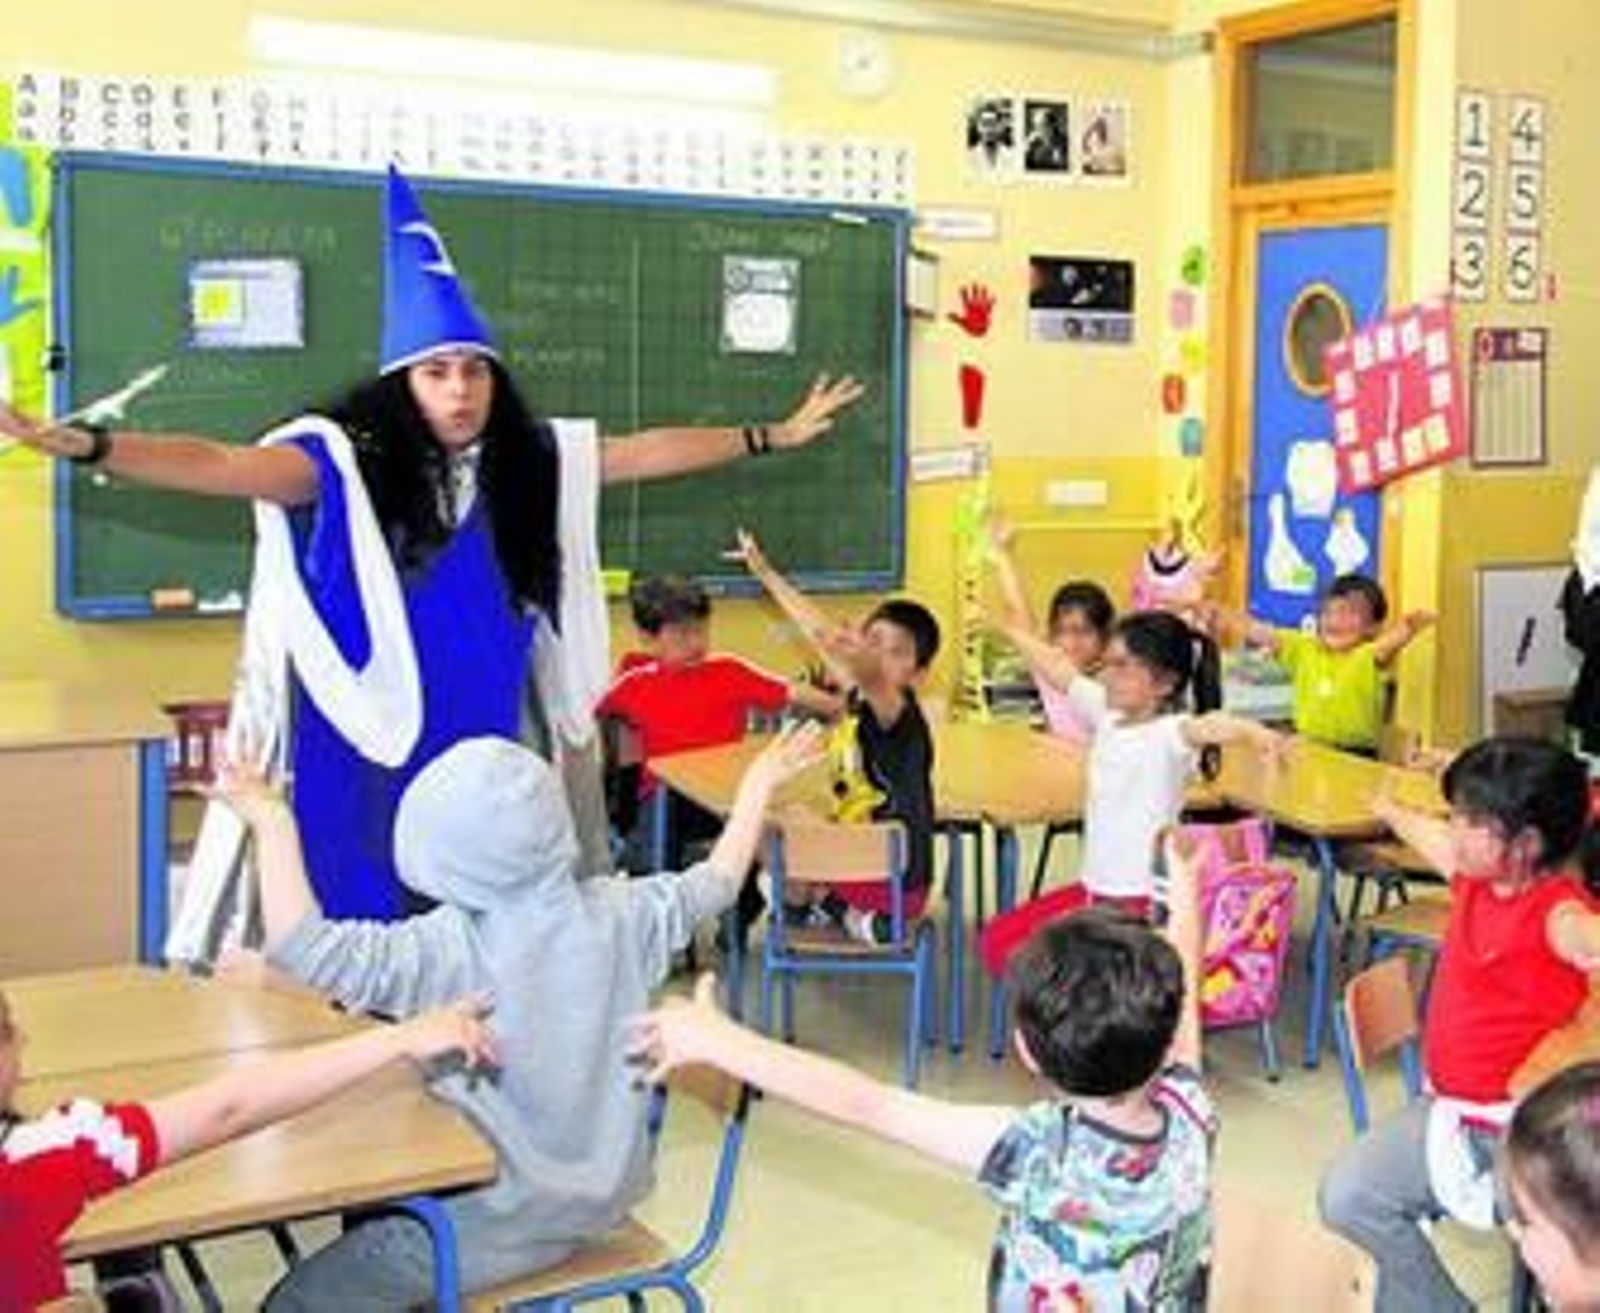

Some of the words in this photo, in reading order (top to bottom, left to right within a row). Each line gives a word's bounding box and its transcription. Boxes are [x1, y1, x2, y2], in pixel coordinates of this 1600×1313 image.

[101, 83, 122, 105] C
[1466, 102, 1485, 148] 1
[1510, 107, 1539, 152] 4
[1459, 170, 1485, 219] 2
[1512, 173, 1537, 220] 5
[1455, 241, 1484, 291] 3
[1509, 245, 1537, 291] 6
